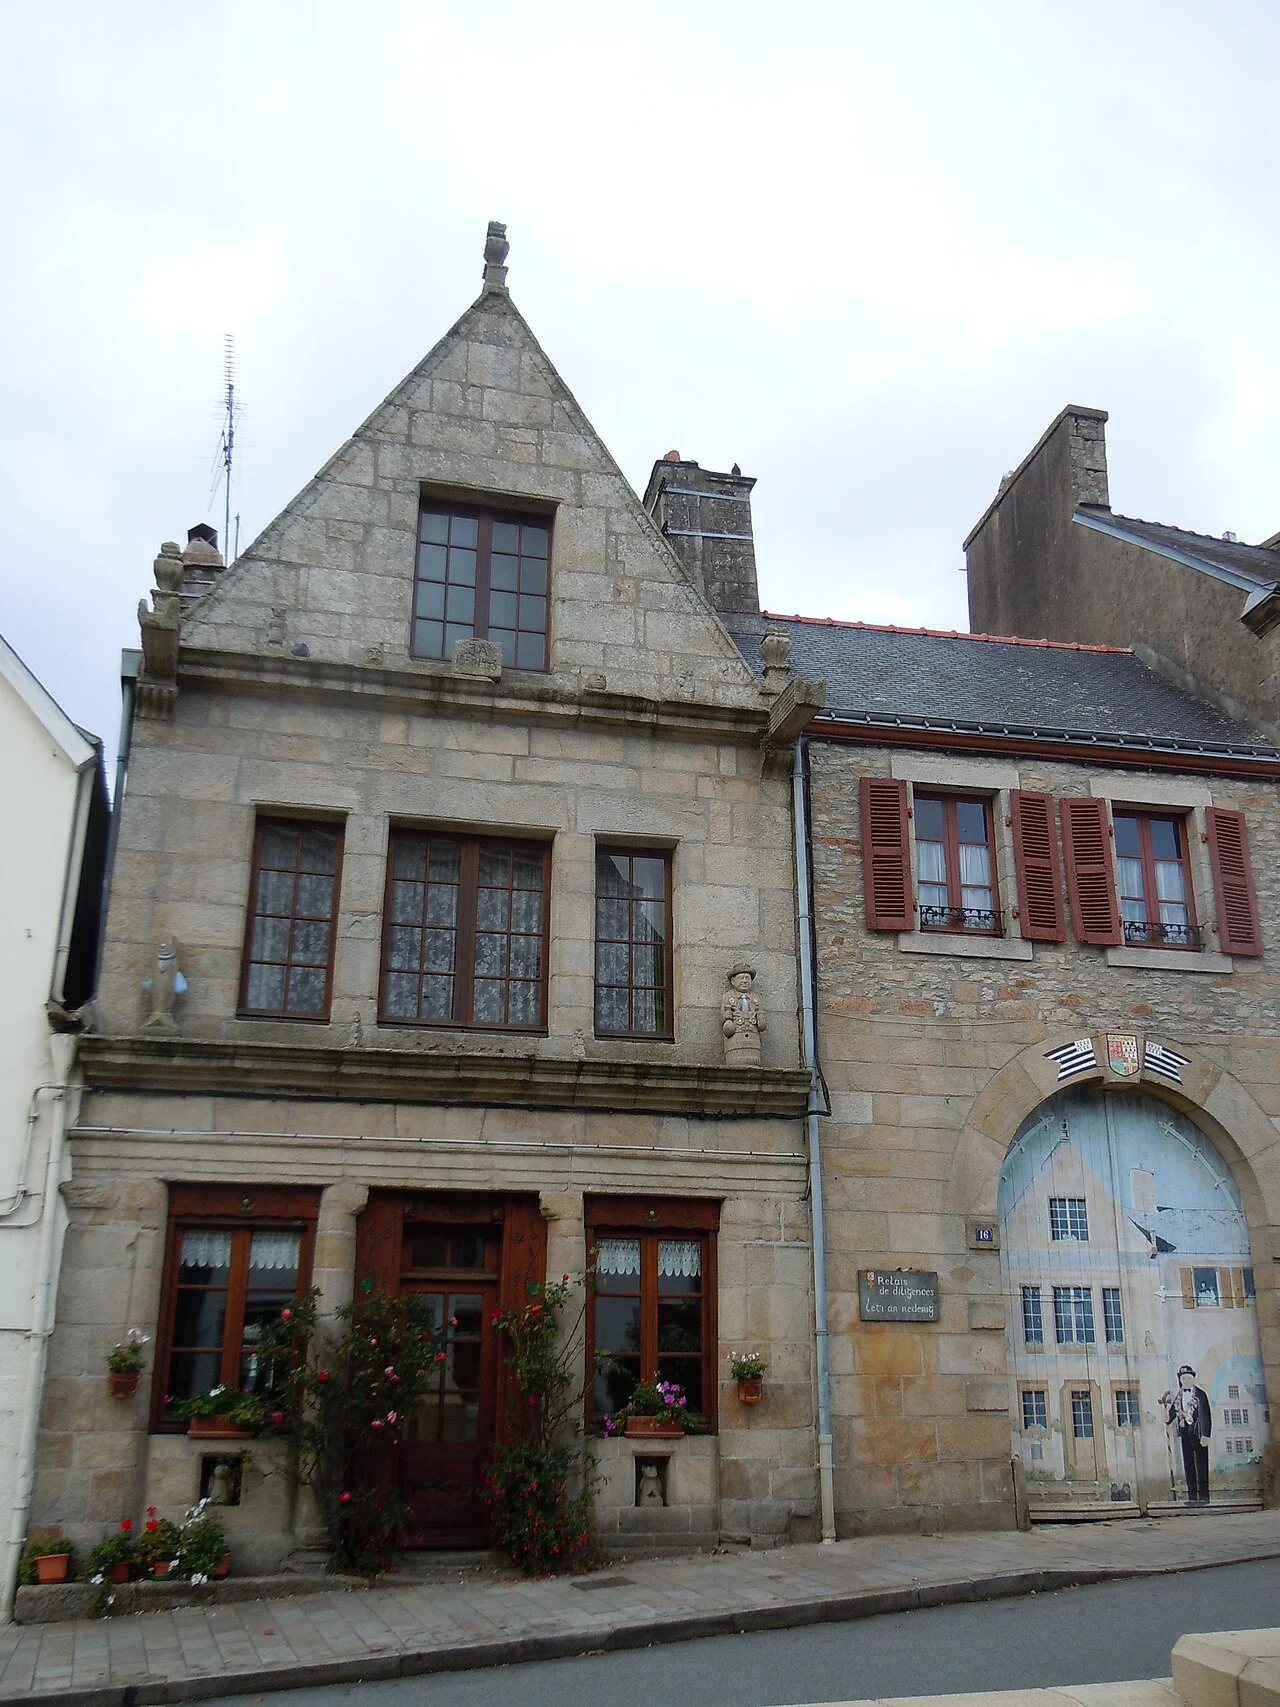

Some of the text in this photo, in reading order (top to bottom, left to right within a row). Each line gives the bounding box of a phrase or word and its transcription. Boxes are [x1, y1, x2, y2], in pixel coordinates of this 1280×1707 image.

[980, 1230, 989, 1240] 16
[877, 1276, 908, 1286] Relais
[879, 1286, 935, 1299] de diligences
